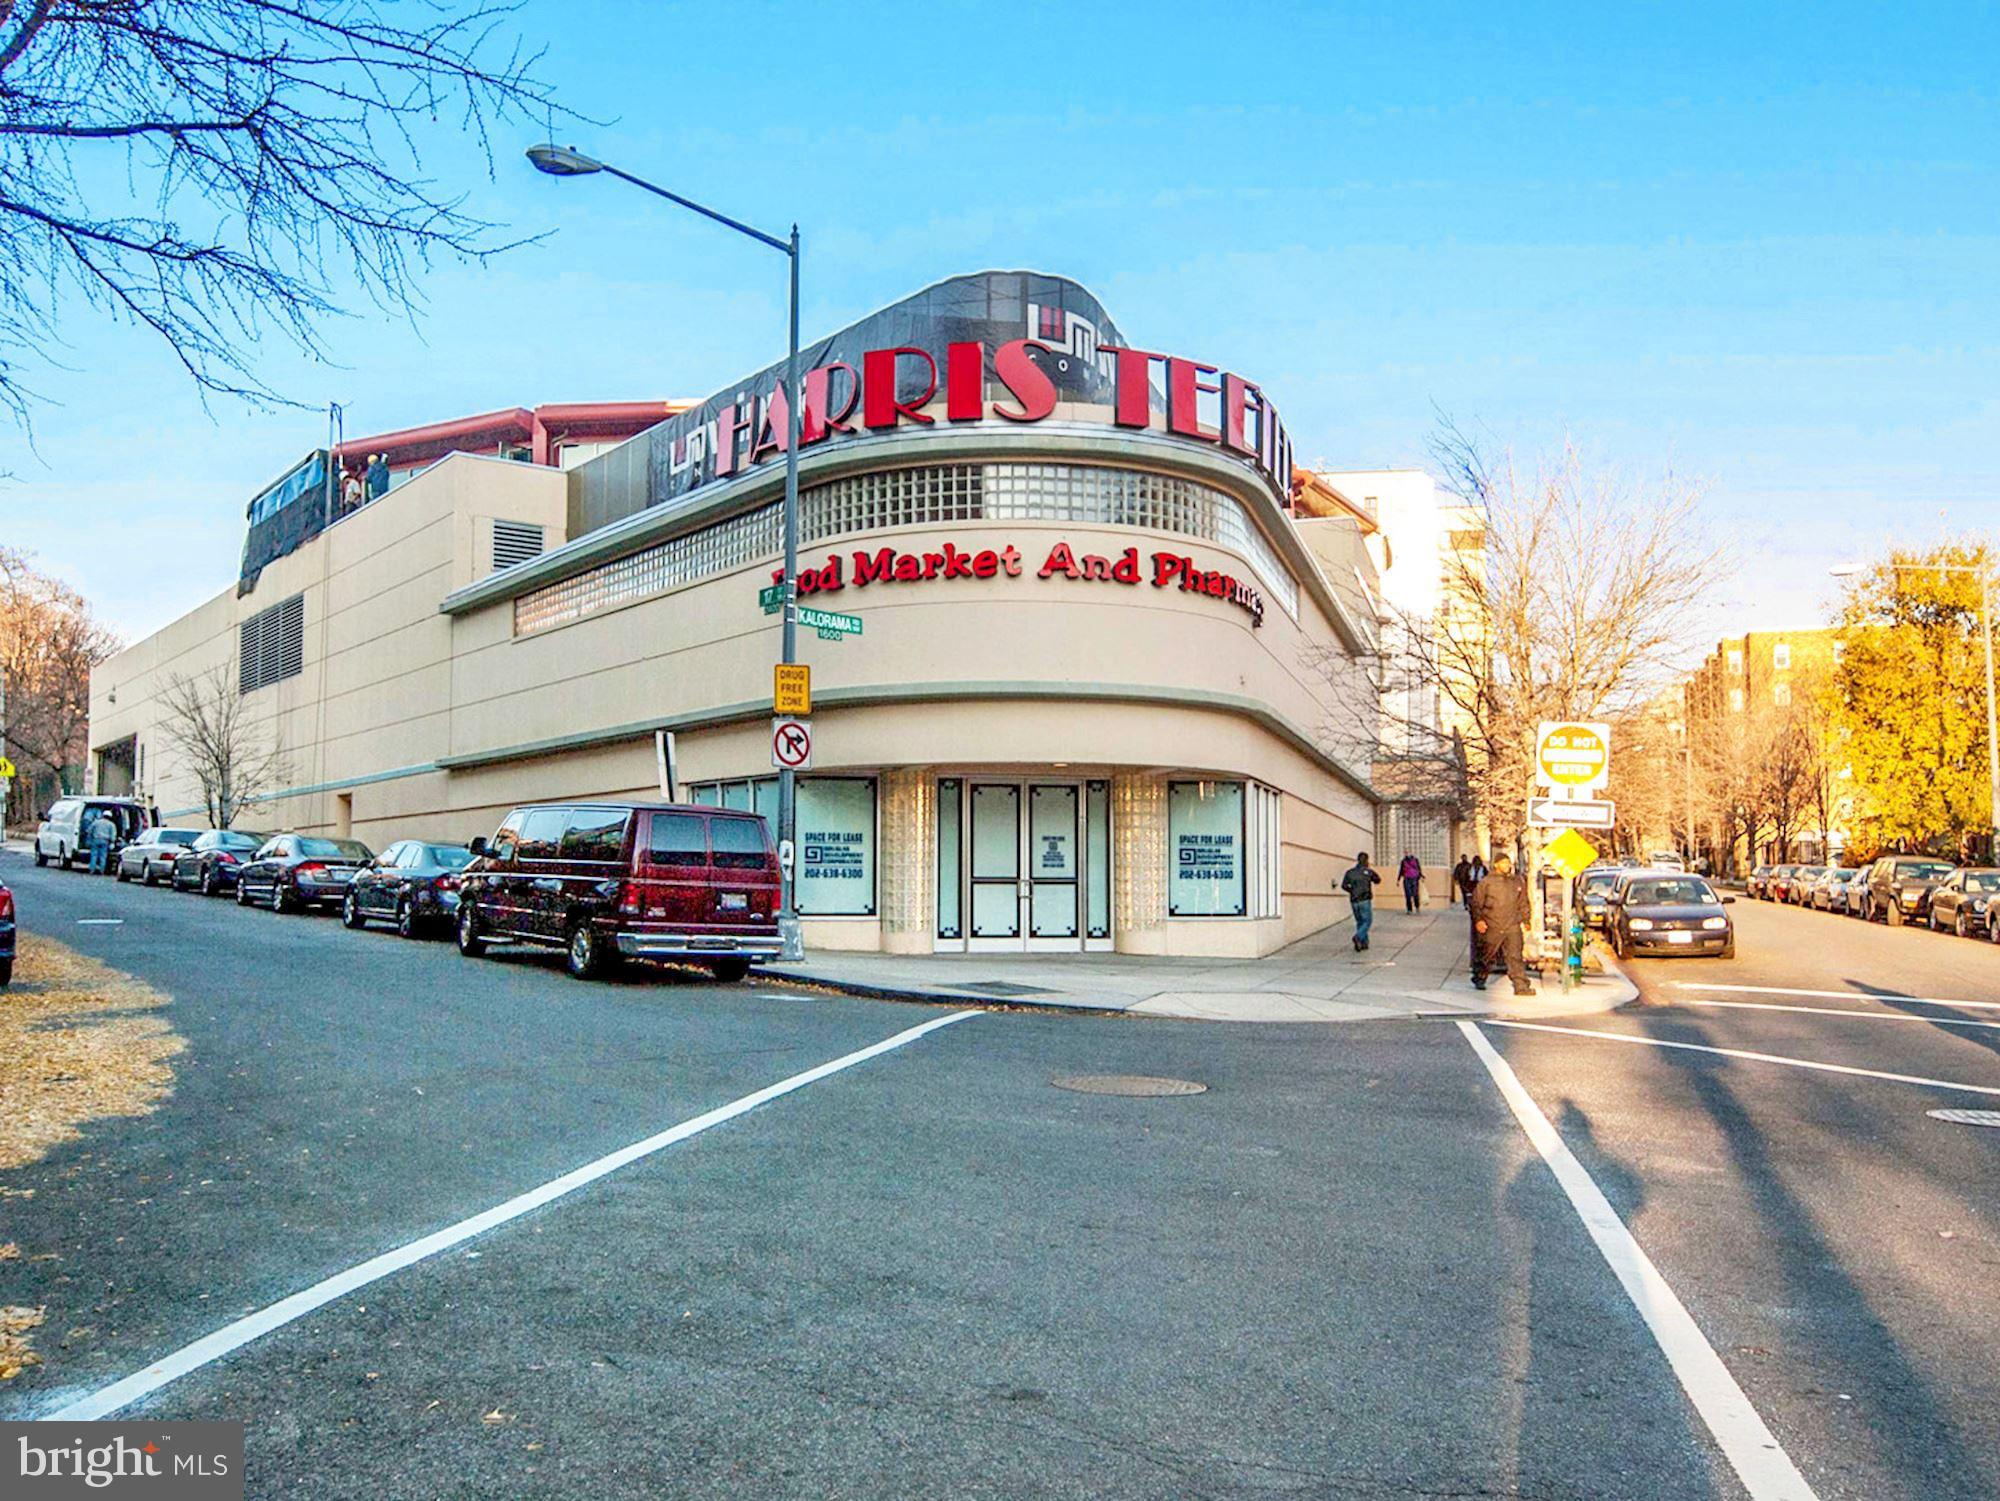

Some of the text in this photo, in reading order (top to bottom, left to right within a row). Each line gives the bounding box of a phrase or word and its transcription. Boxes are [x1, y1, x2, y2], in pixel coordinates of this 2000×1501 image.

[715, 339, 1293, 508] HARRIS TEE
[852, 543, 1023, 587] Market
[1037, 543, 1143, 584] And
[1151, 552, 1264, 628] Pharm
[798, 609, 852, 631] KALORAMA
[819, 628, 841, 640] 1600
[780, 670, 805, 680] DRUG
[781, 683, 803, 694] FREE
[781, 696, 803, 707] ZONE
[1549, 736, 1598, 748] DO NOT
[805, 832, 863, 843] SPACE FOR LEASE
[1179, 835, 1233, 845] SPACE FOR LEASE
